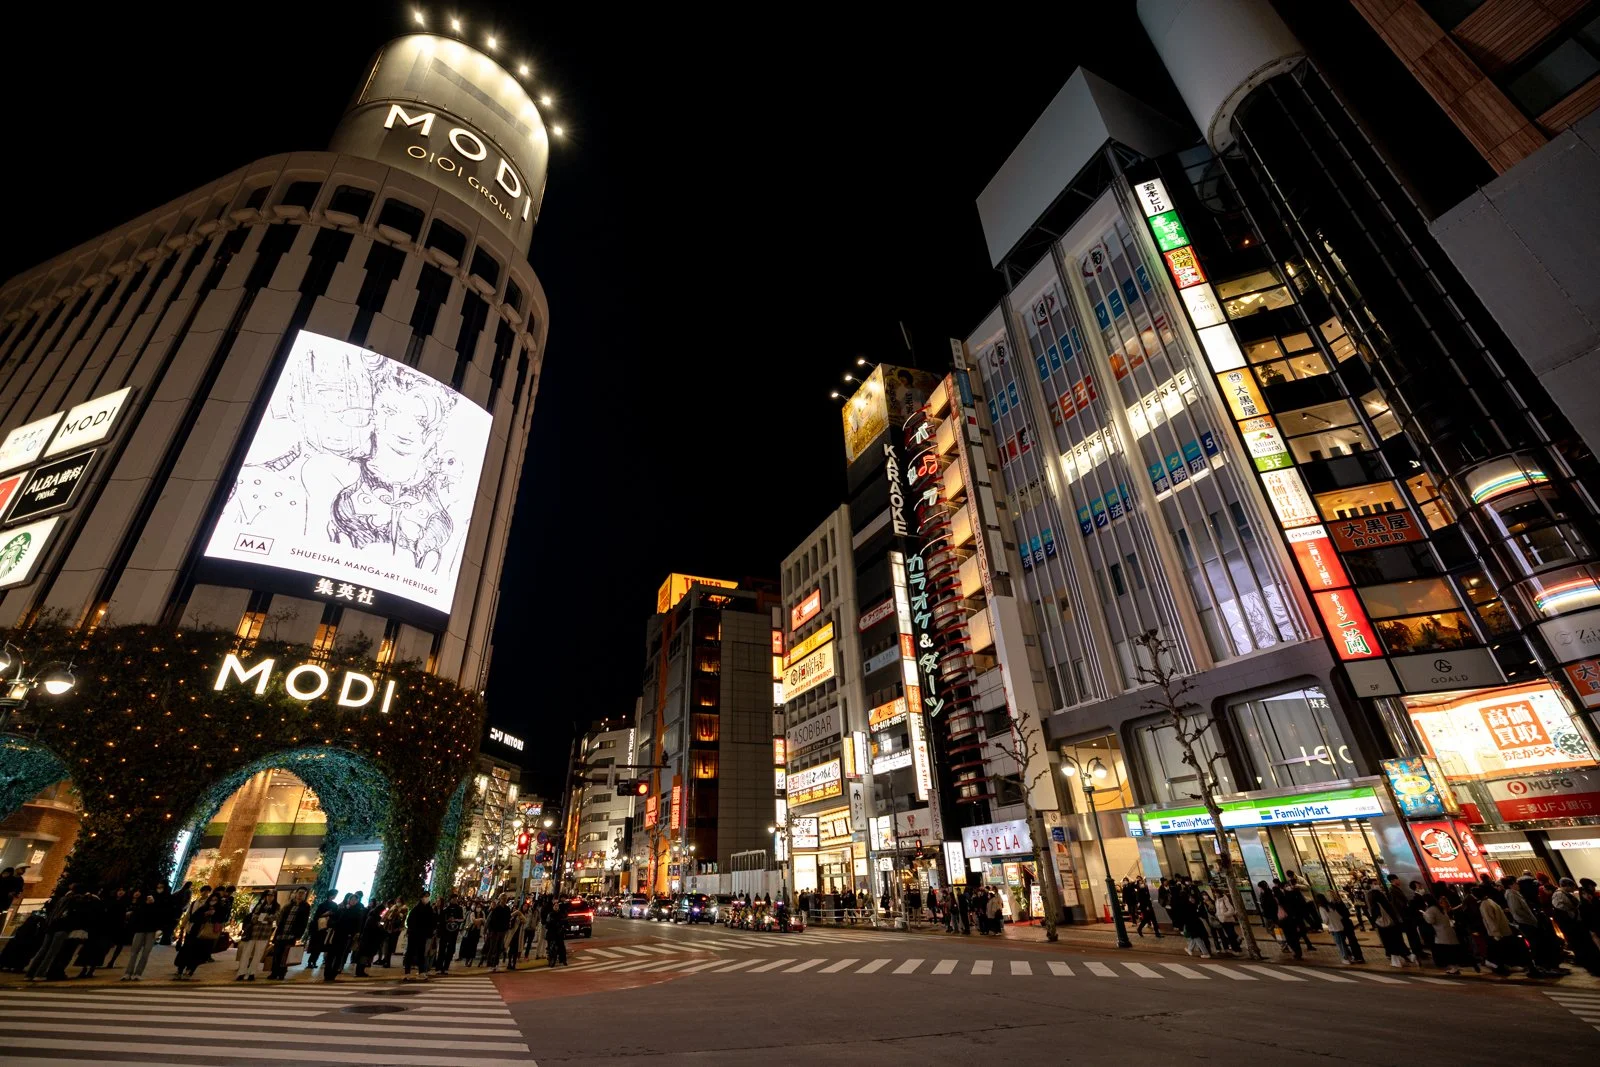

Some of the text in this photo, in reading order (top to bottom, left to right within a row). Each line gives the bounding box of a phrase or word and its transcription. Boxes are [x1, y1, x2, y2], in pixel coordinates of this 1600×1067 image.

[383, 104, 531, 222] MODI
[467, 175, 513, 221] GROUP
[1234, 385, 1259, 417] 大黒屋
[59, 406, 117, 438] MODI
[1265, 459, 1283, 469] 3F
[25, 464, 84, 496] ALBA歯科
[883, 443, 909, 536] KARAOKE
[34, 487, 59, 502] PRIME
[1342, 513, 1410, 538] 大黒屋
[239, 538, 267, 551] MA
[289, 547, 439, 596] SHUEISHA MANGA-ART HERITAGE
[313, 577, 376, 606] 集英社
[906, 553, 945, 718] カラオケ&ダーツ
[1337, 620, 1372, 655] 一蘭
[213, 653, 396, 714] MODI
[1431, 674, 1469, 684] GOALD
[1487, 703, 1534, 728] 高価
[489, 727, 525, 752] ニトリ NITORI
[1493, 723, 1544, 747] 買取
[1501, 745, 1558, 762] おたからや
[1527, 777, 1574, 792] MUFG
[1273, 804, 1331, 819] FamilyMart
[1516, 799, 1593, 815] 三菱UFJ銀行
[1171, 815, 1214, 829] FamilyMart
[972, 834, 1021, 853] PASELA
